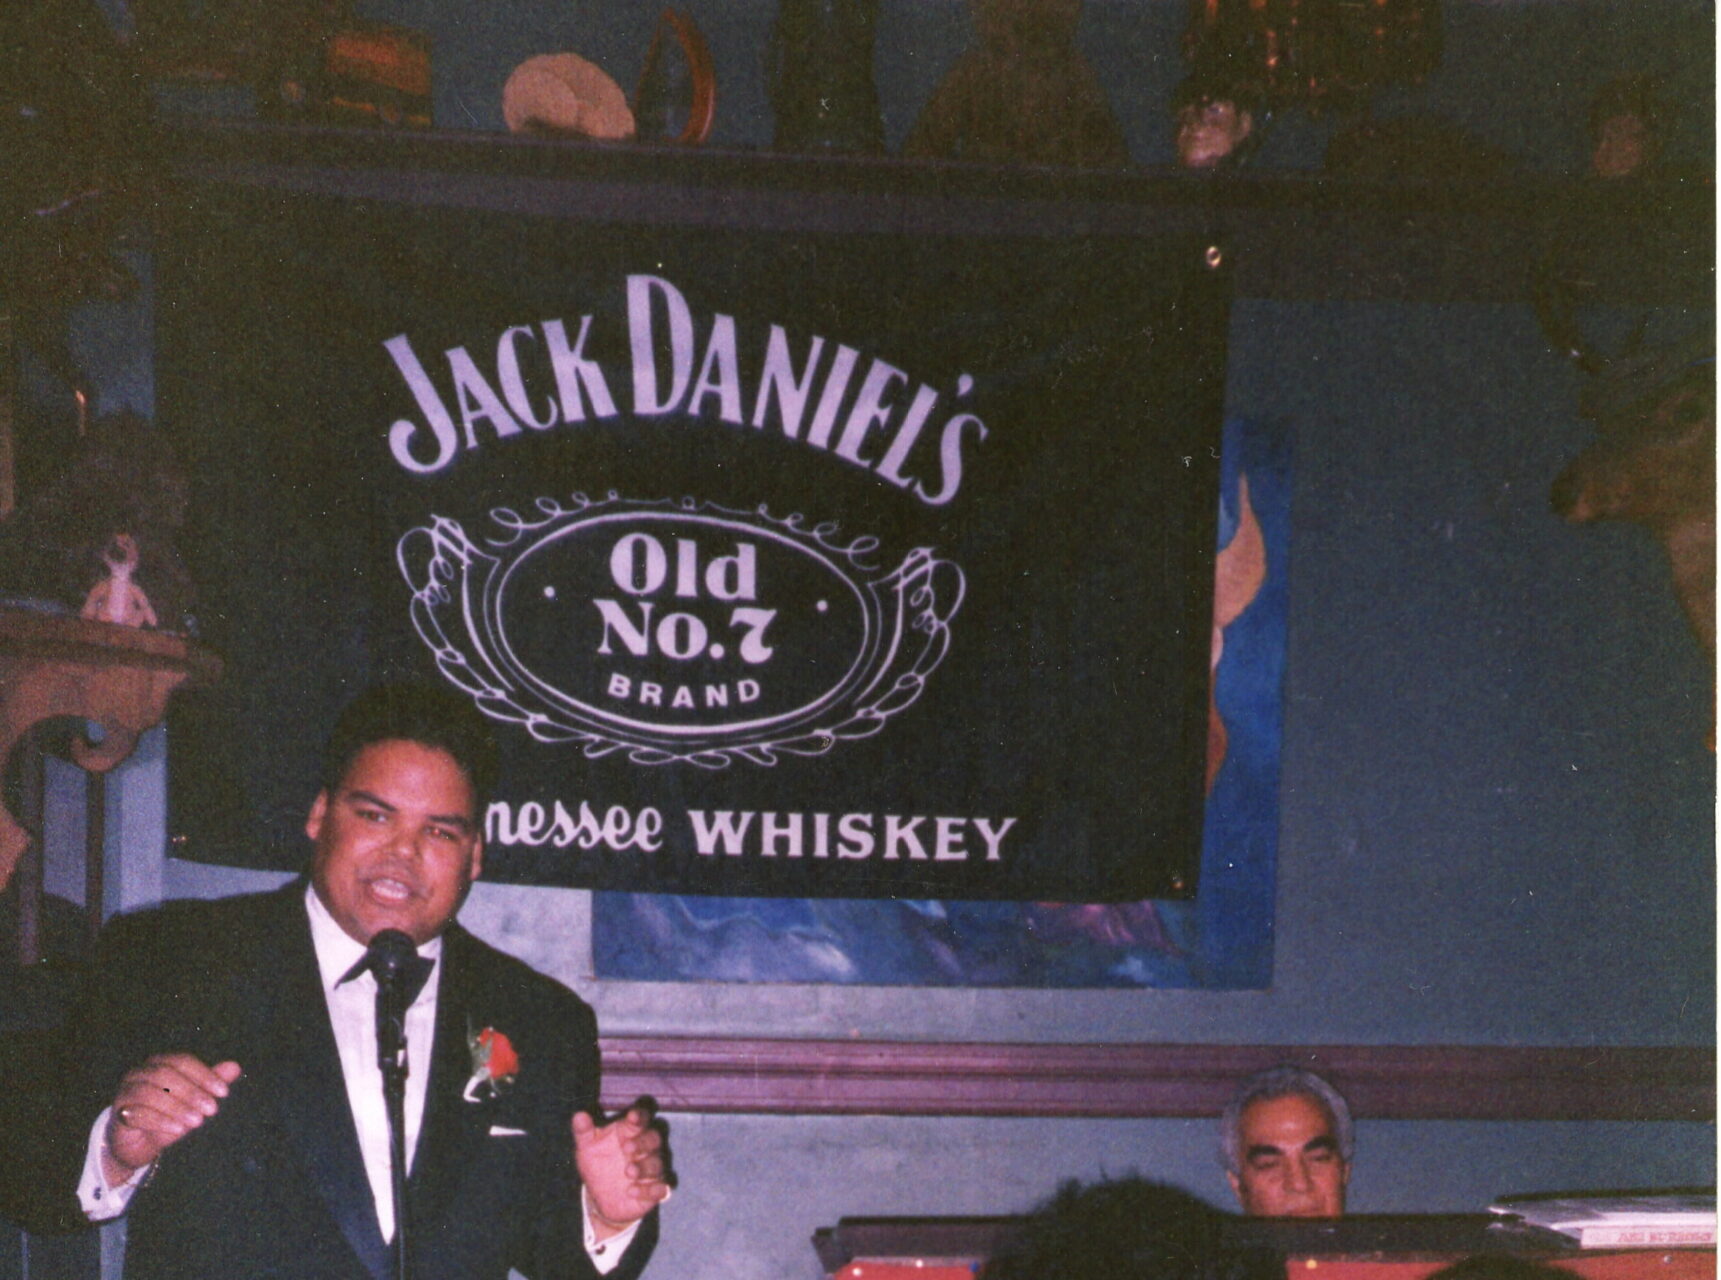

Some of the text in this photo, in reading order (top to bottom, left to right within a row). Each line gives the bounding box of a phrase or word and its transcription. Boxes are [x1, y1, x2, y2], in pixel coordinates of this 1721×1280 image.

[383, 274, 990, 504] JACK DANIEL'S
[609, 532, 757, 601] Old
[606, 672, 761, 709] BRAND
[483, 799, 1017, 861] nessee WHISKEY
